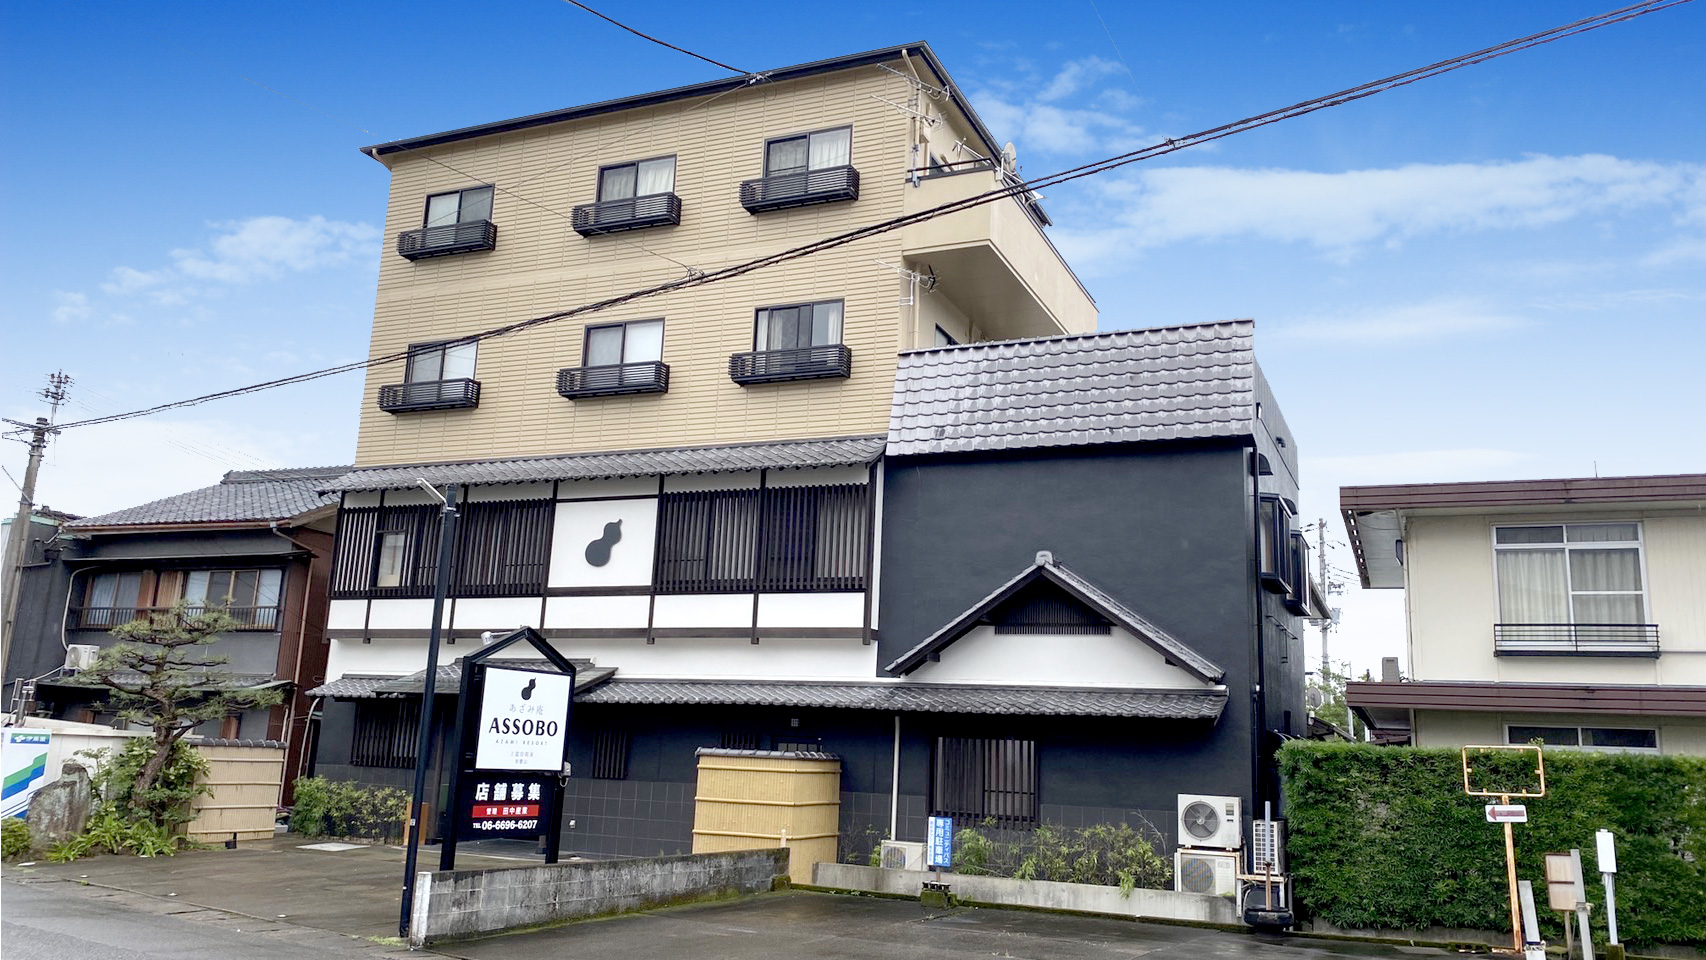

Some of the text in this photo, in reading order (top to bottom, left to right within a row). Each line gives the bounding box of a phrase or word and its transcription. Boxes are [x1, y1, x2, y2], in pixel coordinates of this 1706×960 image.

[488, 717, 558, 737] ASSOBO
[475, 782, 541, 801] 店舗募集
[481, 819, 538, 830] 06-6696-6207
[935, 819, 944, 864] 専用駐車場
